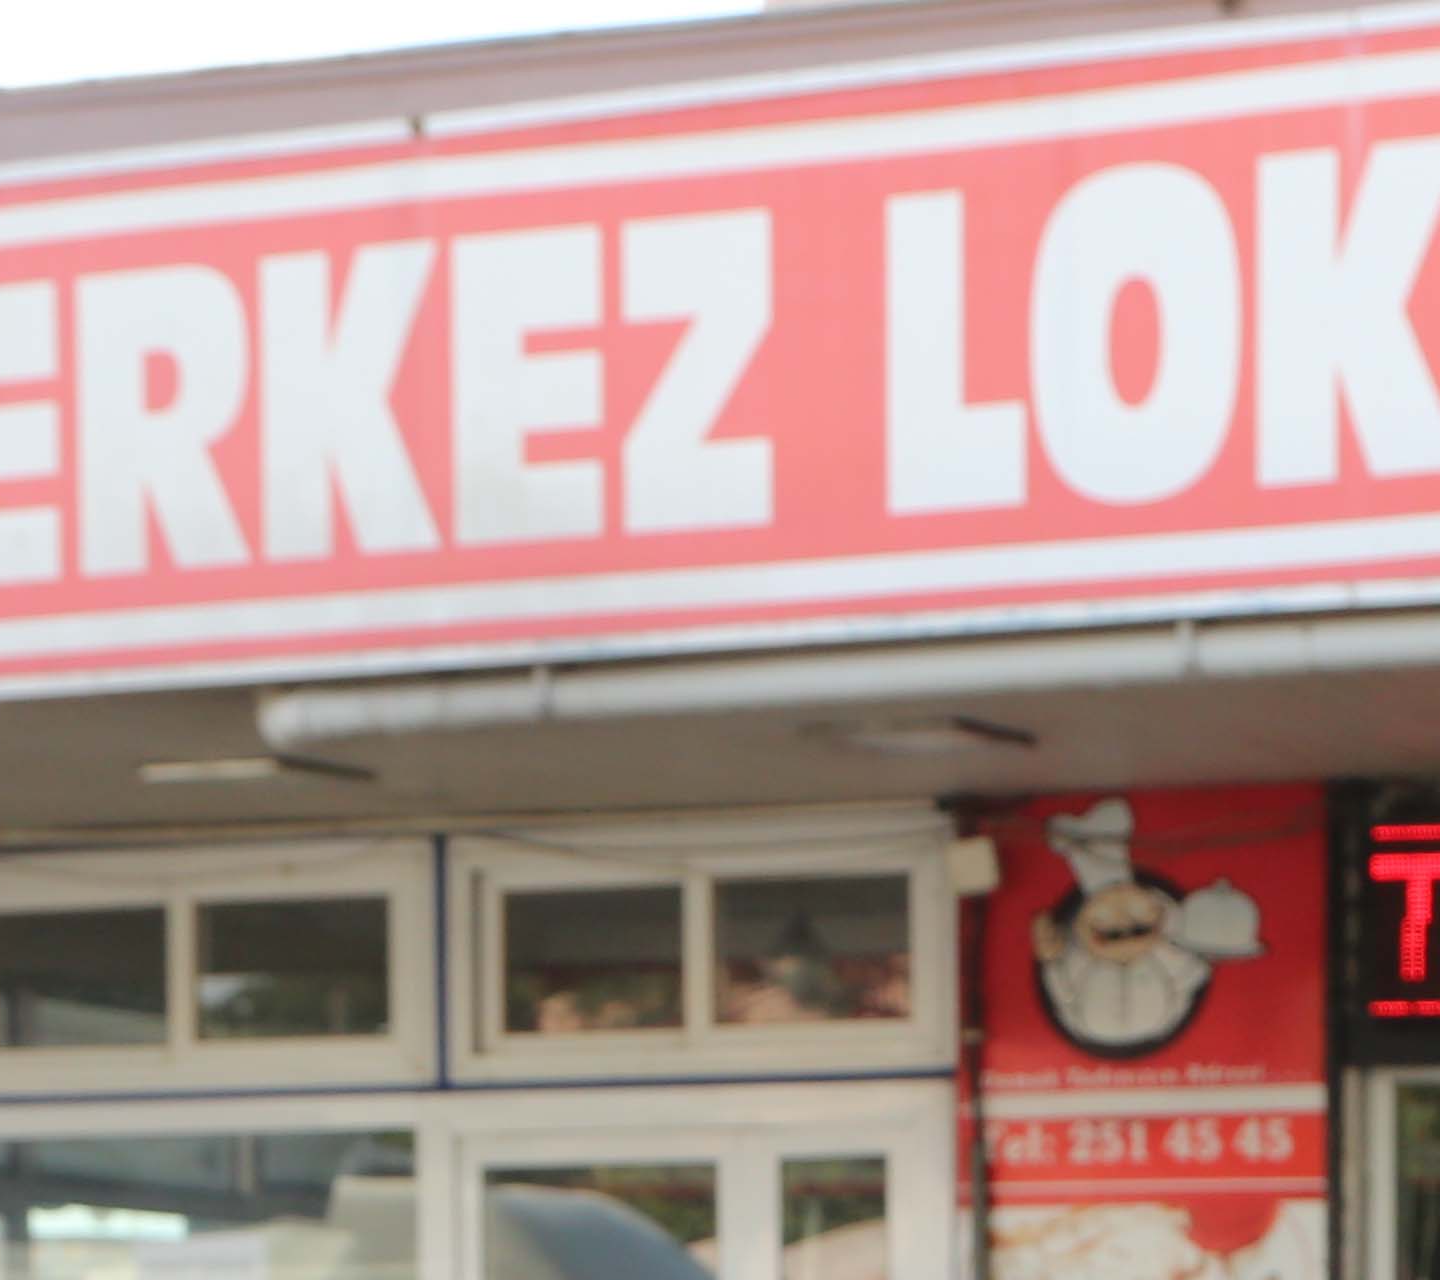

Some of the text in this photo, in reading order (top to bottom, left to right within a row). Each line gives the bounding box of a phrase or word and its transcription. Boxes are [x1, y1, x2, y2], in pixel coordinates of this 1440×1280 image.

[1067, 1116, 1148, 1165] 251
[1163, 1117, 1222, 1164] 45
[1233, 1115, 1295, 1164] 45
